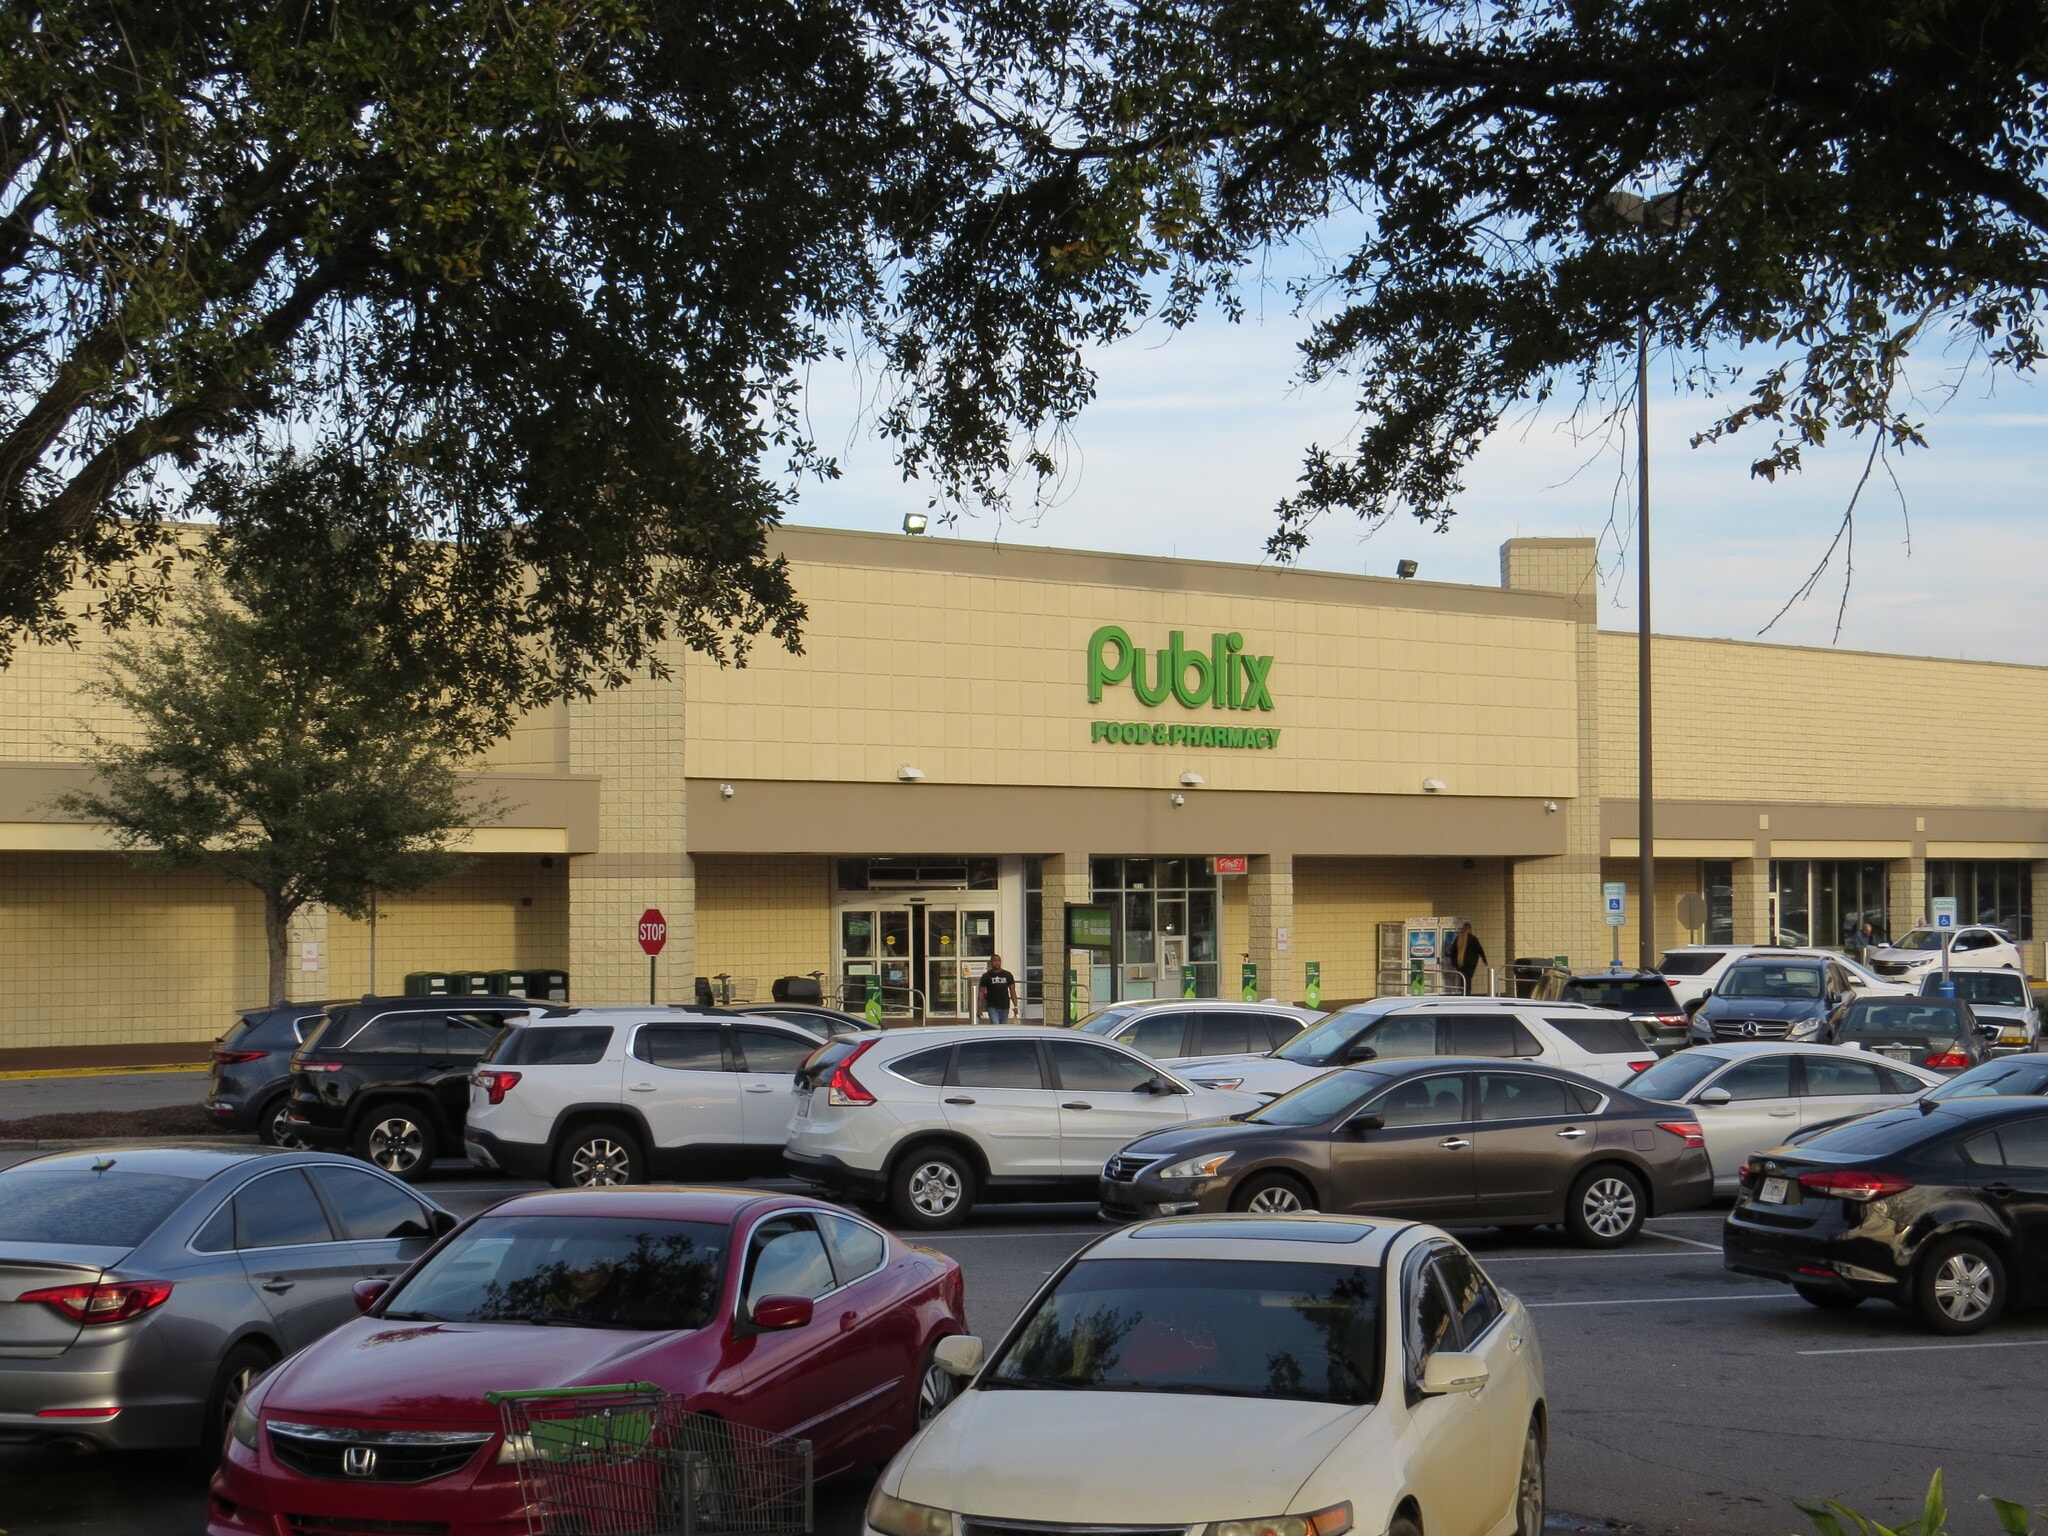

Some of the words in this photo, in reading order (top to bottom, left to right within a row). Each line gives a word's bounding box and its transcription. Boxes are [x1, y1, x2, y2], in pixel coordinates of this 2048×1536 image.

[1087, 625, 1275, 711] Publix
[1091, 721, 1152, 744] FOOD
[1169, 725, 1281, 749] PHARMACY
[640, 923, 665, 941] STOP
